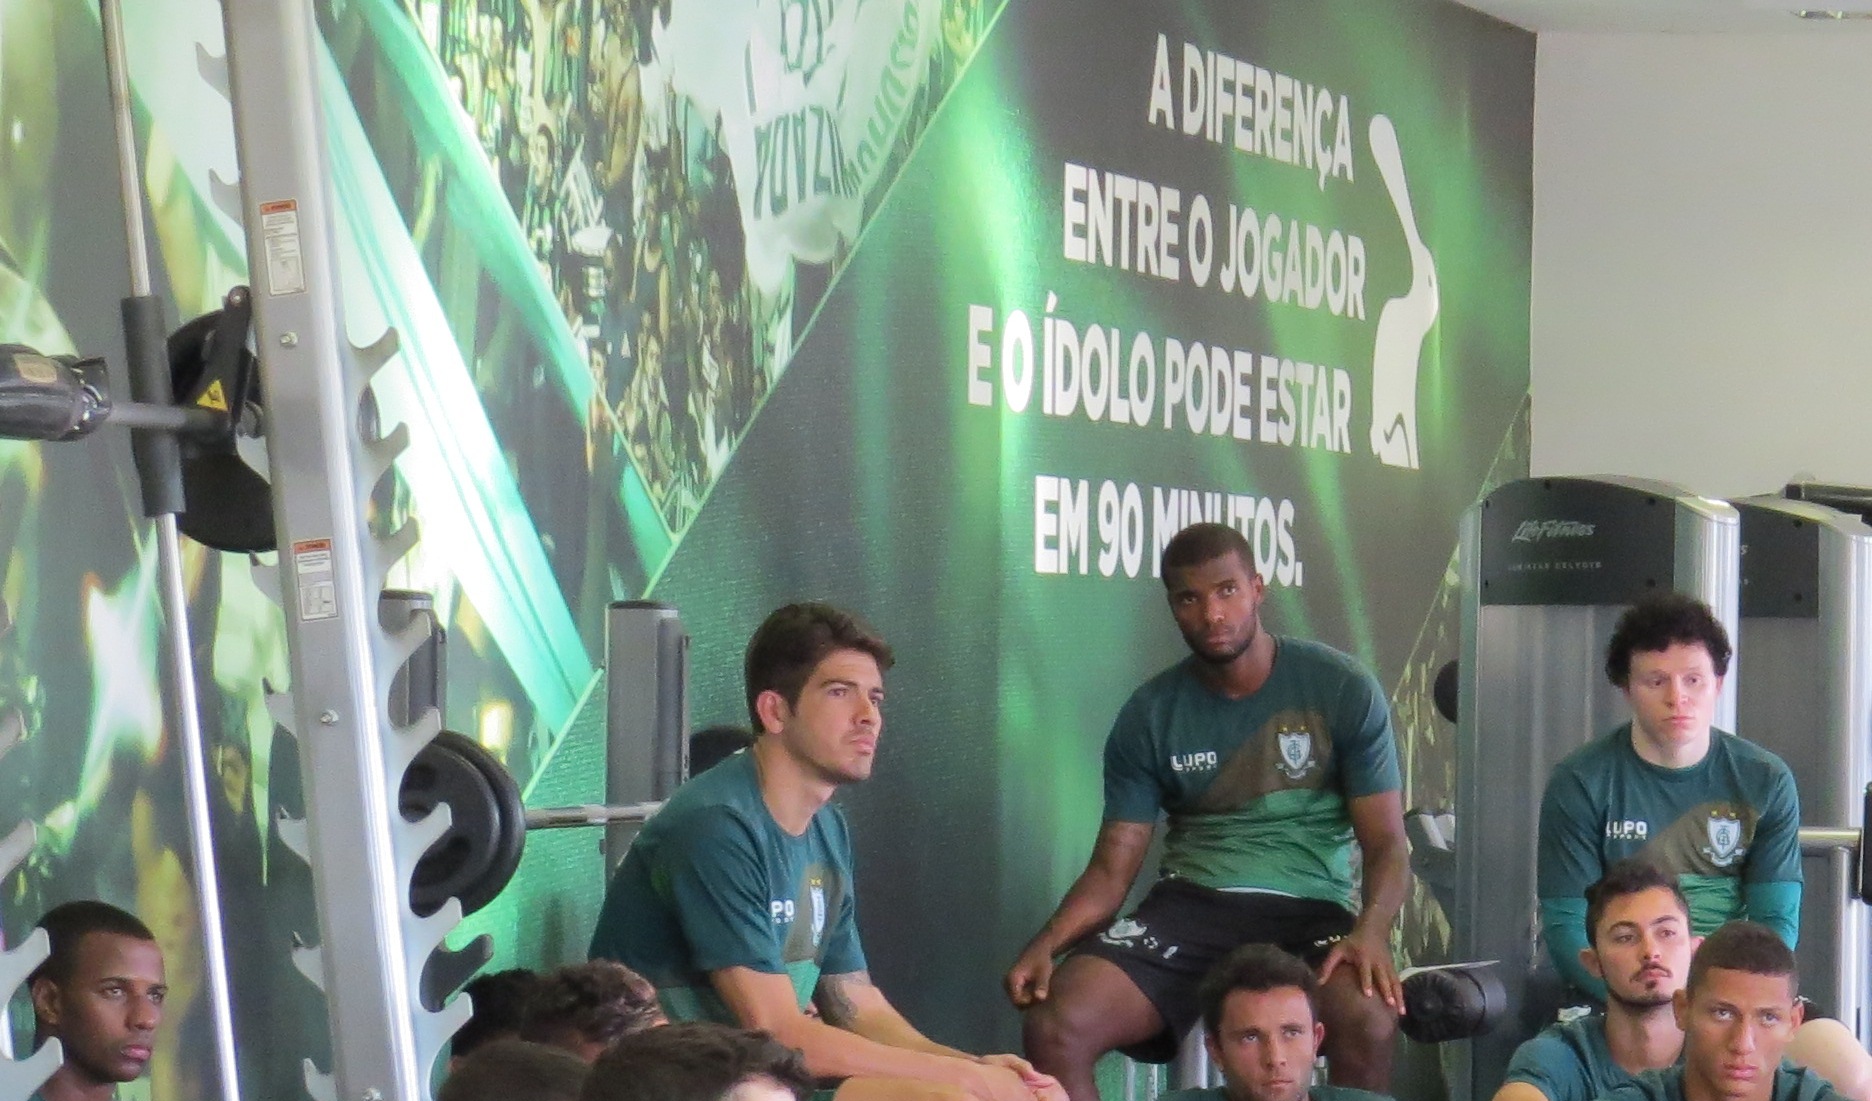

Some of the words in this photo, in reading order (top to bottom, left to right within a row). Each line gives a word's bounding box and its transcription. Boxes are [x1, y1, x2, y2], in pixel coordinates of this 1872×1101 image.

[1148, 33, 1174, 130] A
[1183, 42, 1354, 192] DIFERENÇA
[1063, 161, 1180, 282] ENTRE
[1187, 194, 1213, 288] O
[1220, 204, 1366, 321] JOGADOR
[967, 304, 993, 407] E
[1002, 309, 1034, 413] O
[1042, 290, 1156, 427] ÍDOLO
[1164, 336, 1252, 441] PODE
[1260, 355, 1352, 455] ESTAR
[1034, 475, 1088, 575] EM
[1098, 479, 1143, 578] 90
[1169, 751, 1217, 771] LUPO
[1605, 820, 1648, 838] LUPO
[771, 899, 795, 918] PO
